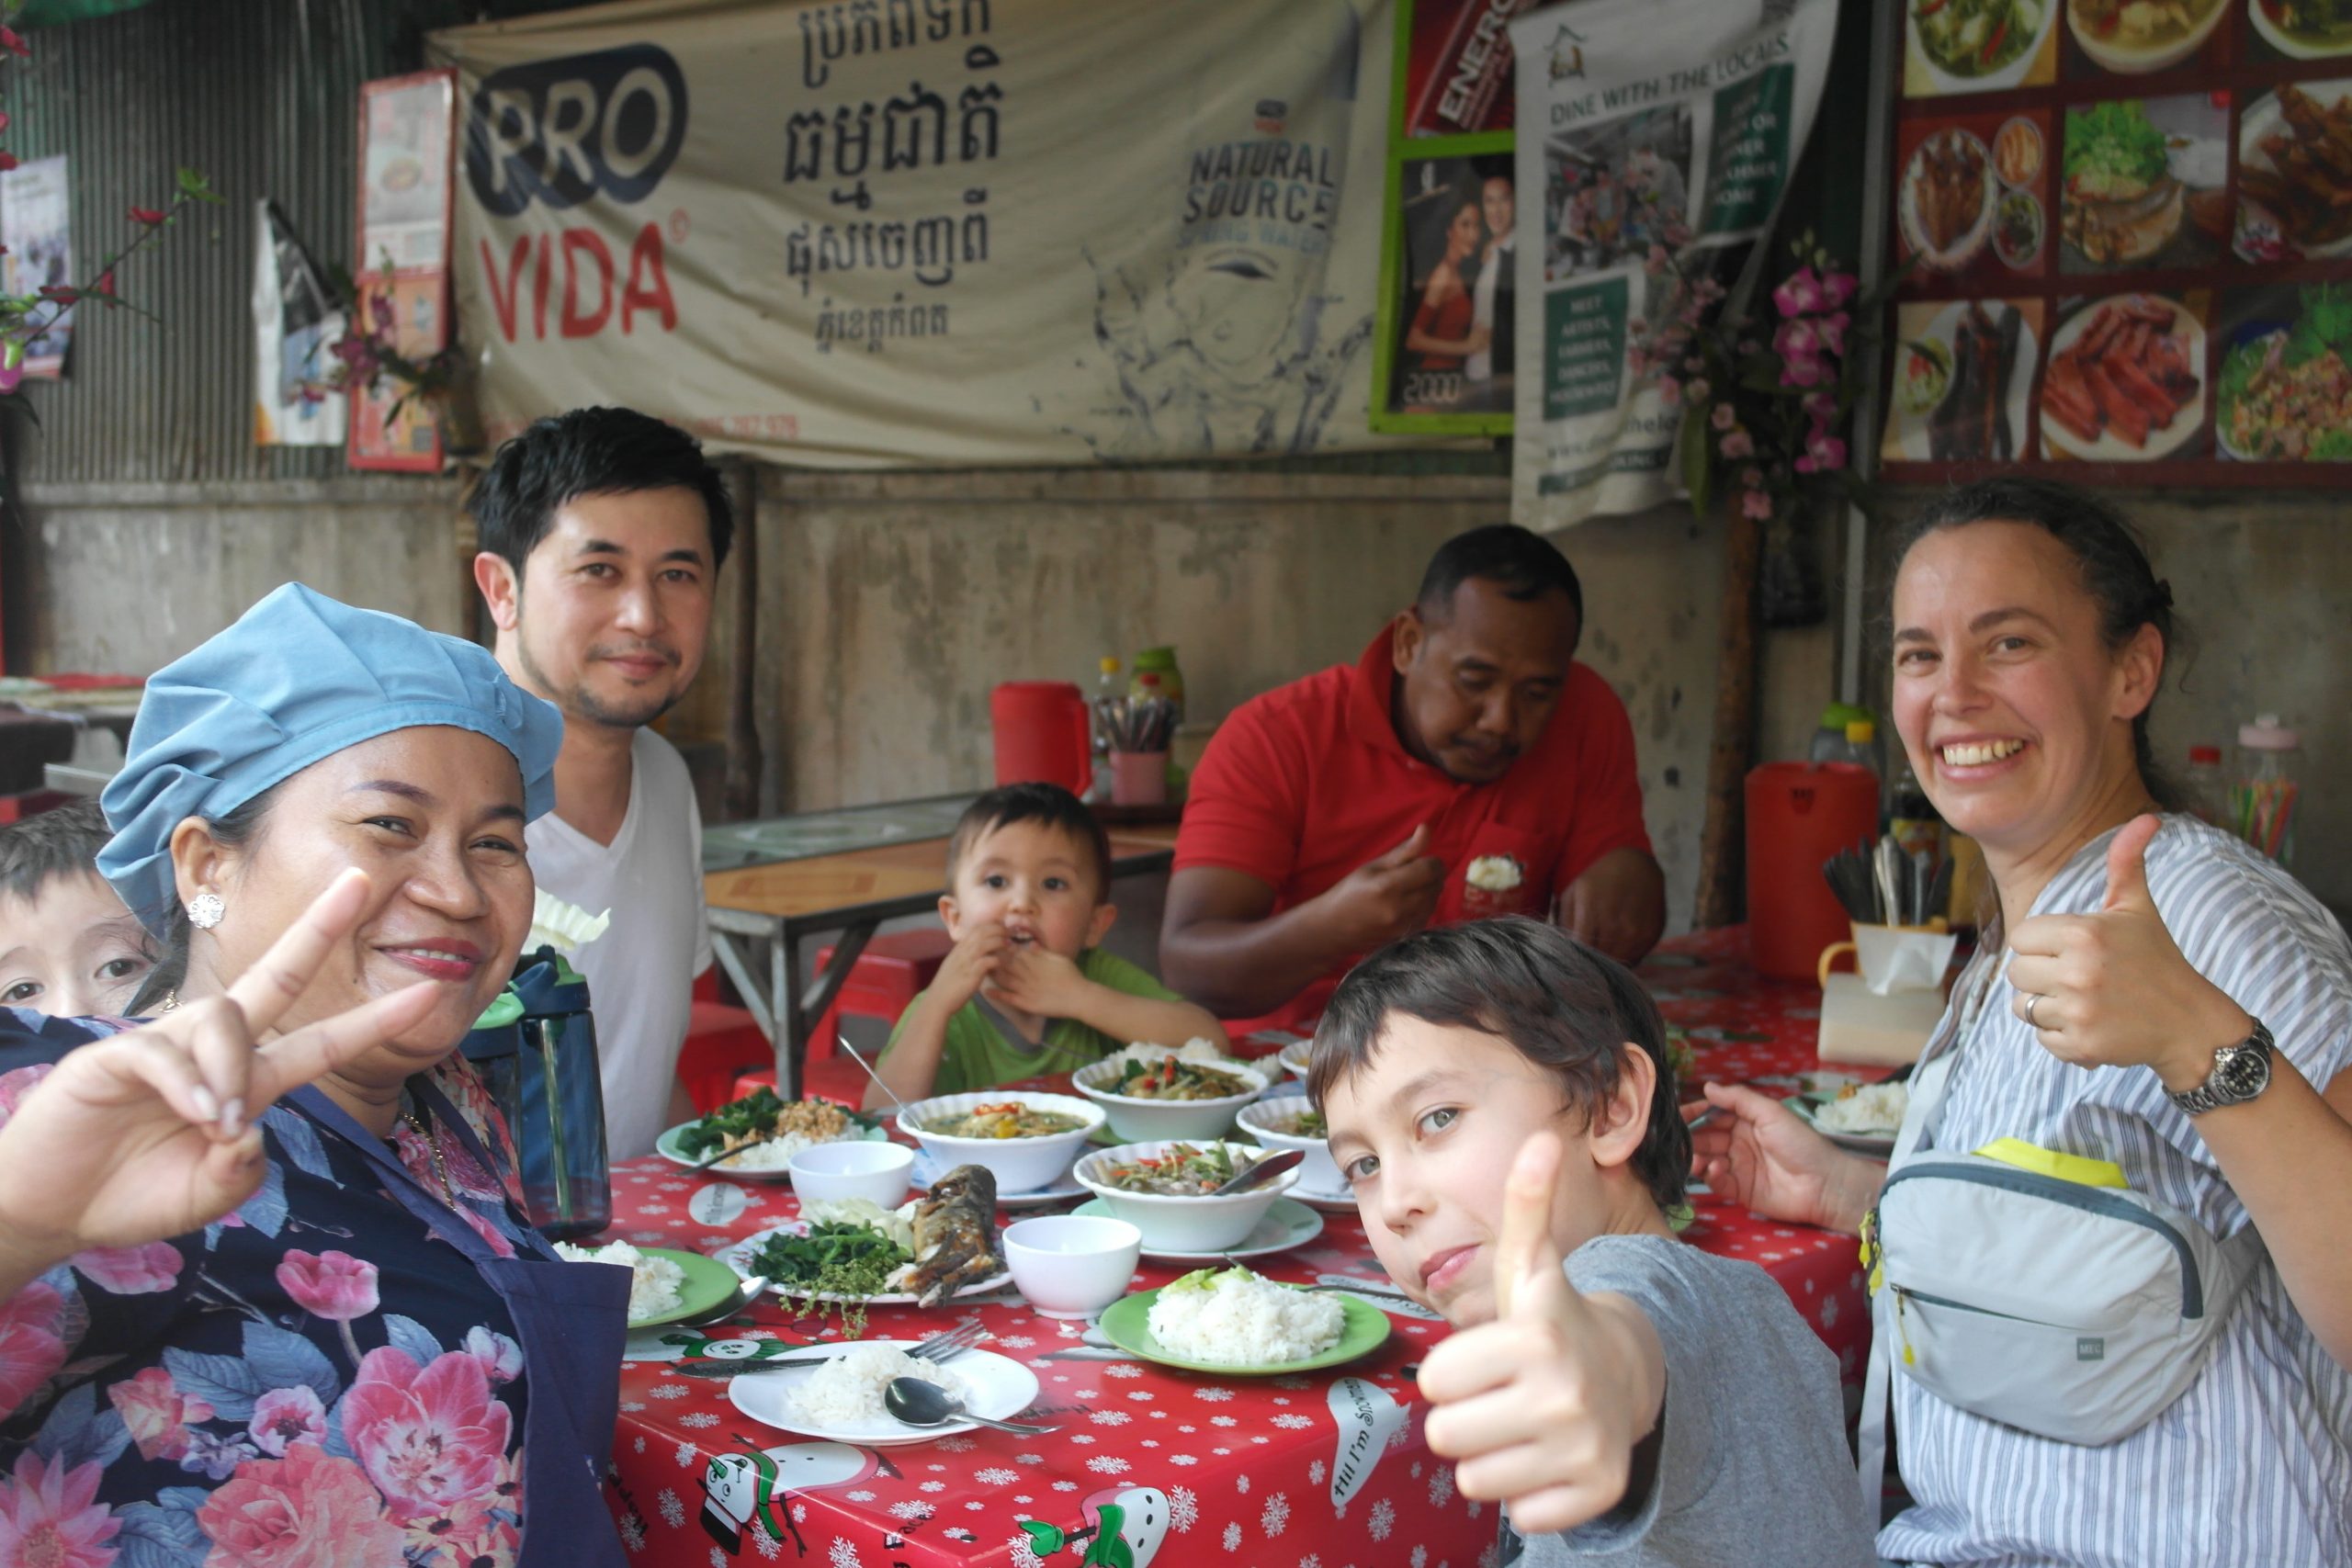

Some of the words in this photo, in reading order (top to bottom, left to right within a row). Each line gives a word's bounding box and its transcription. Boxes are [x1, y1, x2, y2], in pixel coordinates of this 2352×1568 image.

[1550, 92, 1598, 126] DINE
[1602, 77, 1660, 109] WITH
[1668, 63, 1711, 93] THE
[1714, 31, 1790, 81] LOCALS
[489, 67, 673, 194] PRO
[1190, 140, 1335, 188] NATURAL
[1182, 180, 1334, 231] SOURCE
[480, 221, 677, 344] VIDA
